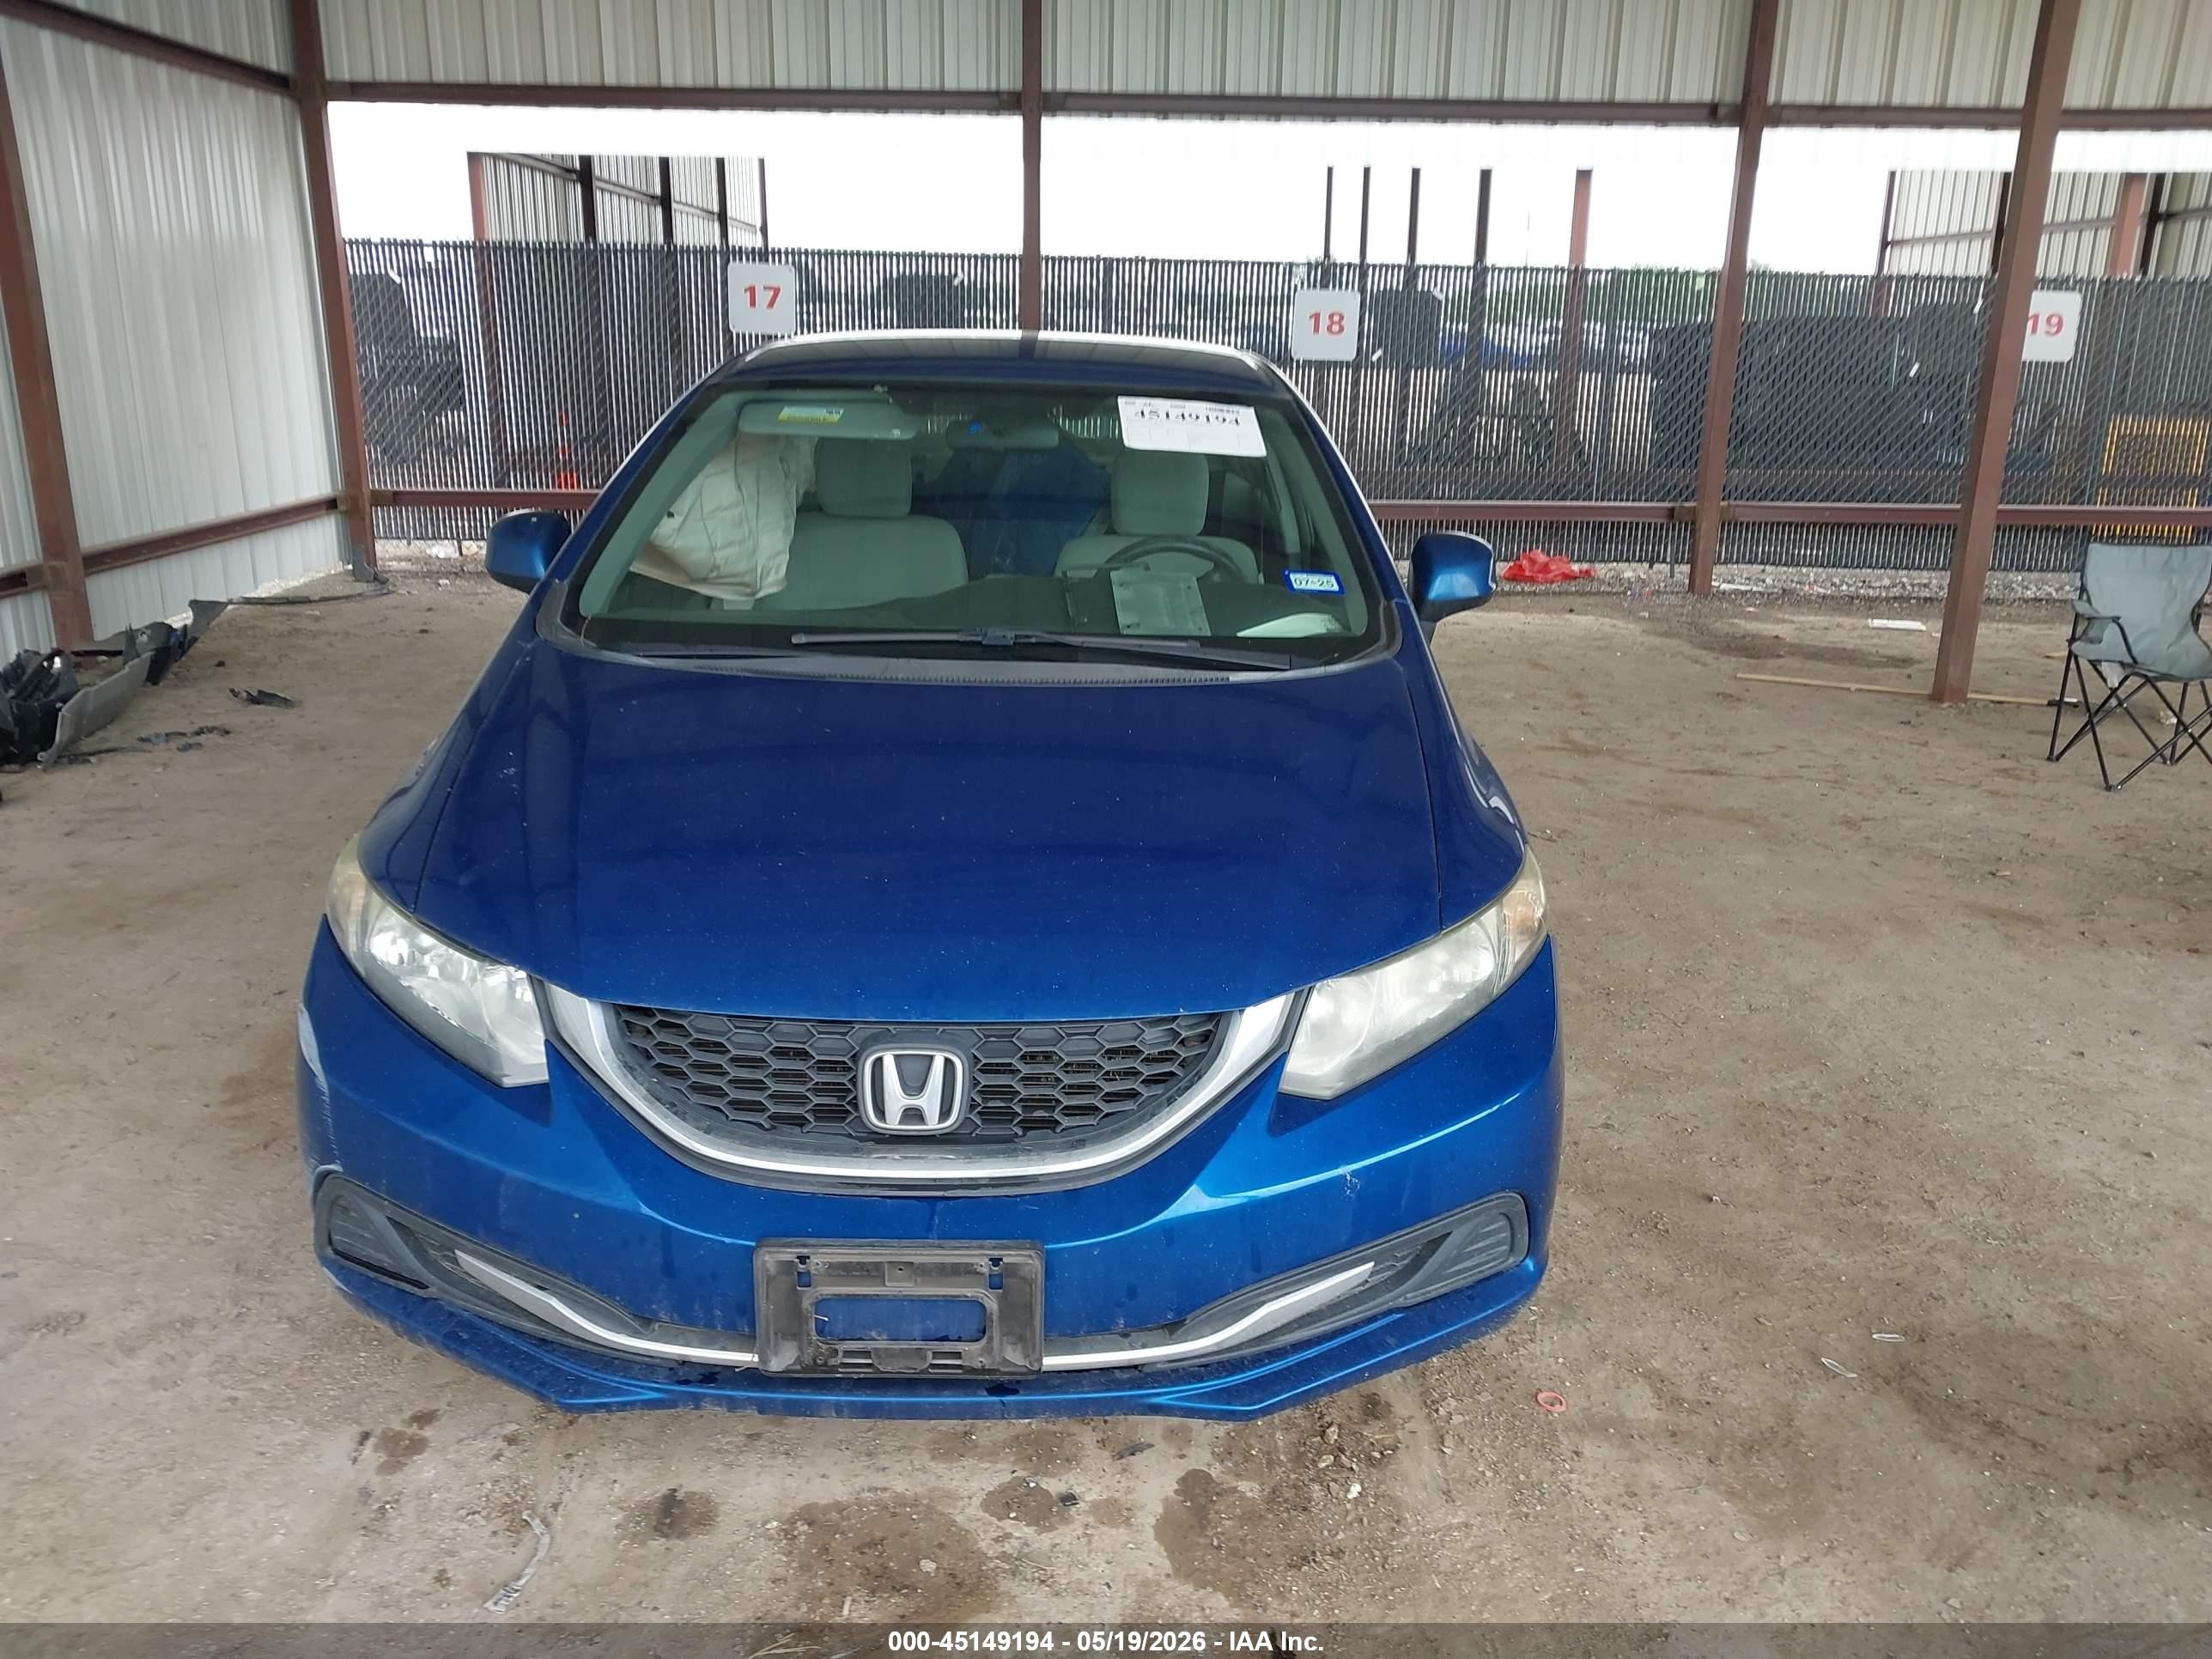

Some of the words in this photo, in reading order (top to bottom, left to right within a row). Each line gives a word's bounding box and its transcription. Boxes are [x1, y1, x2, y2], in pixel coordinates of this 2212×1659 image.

[744, 285, 781, 309] 17
[1309, 311, 1345, 335] 18
[2027, 313, 2063, 336] 19
